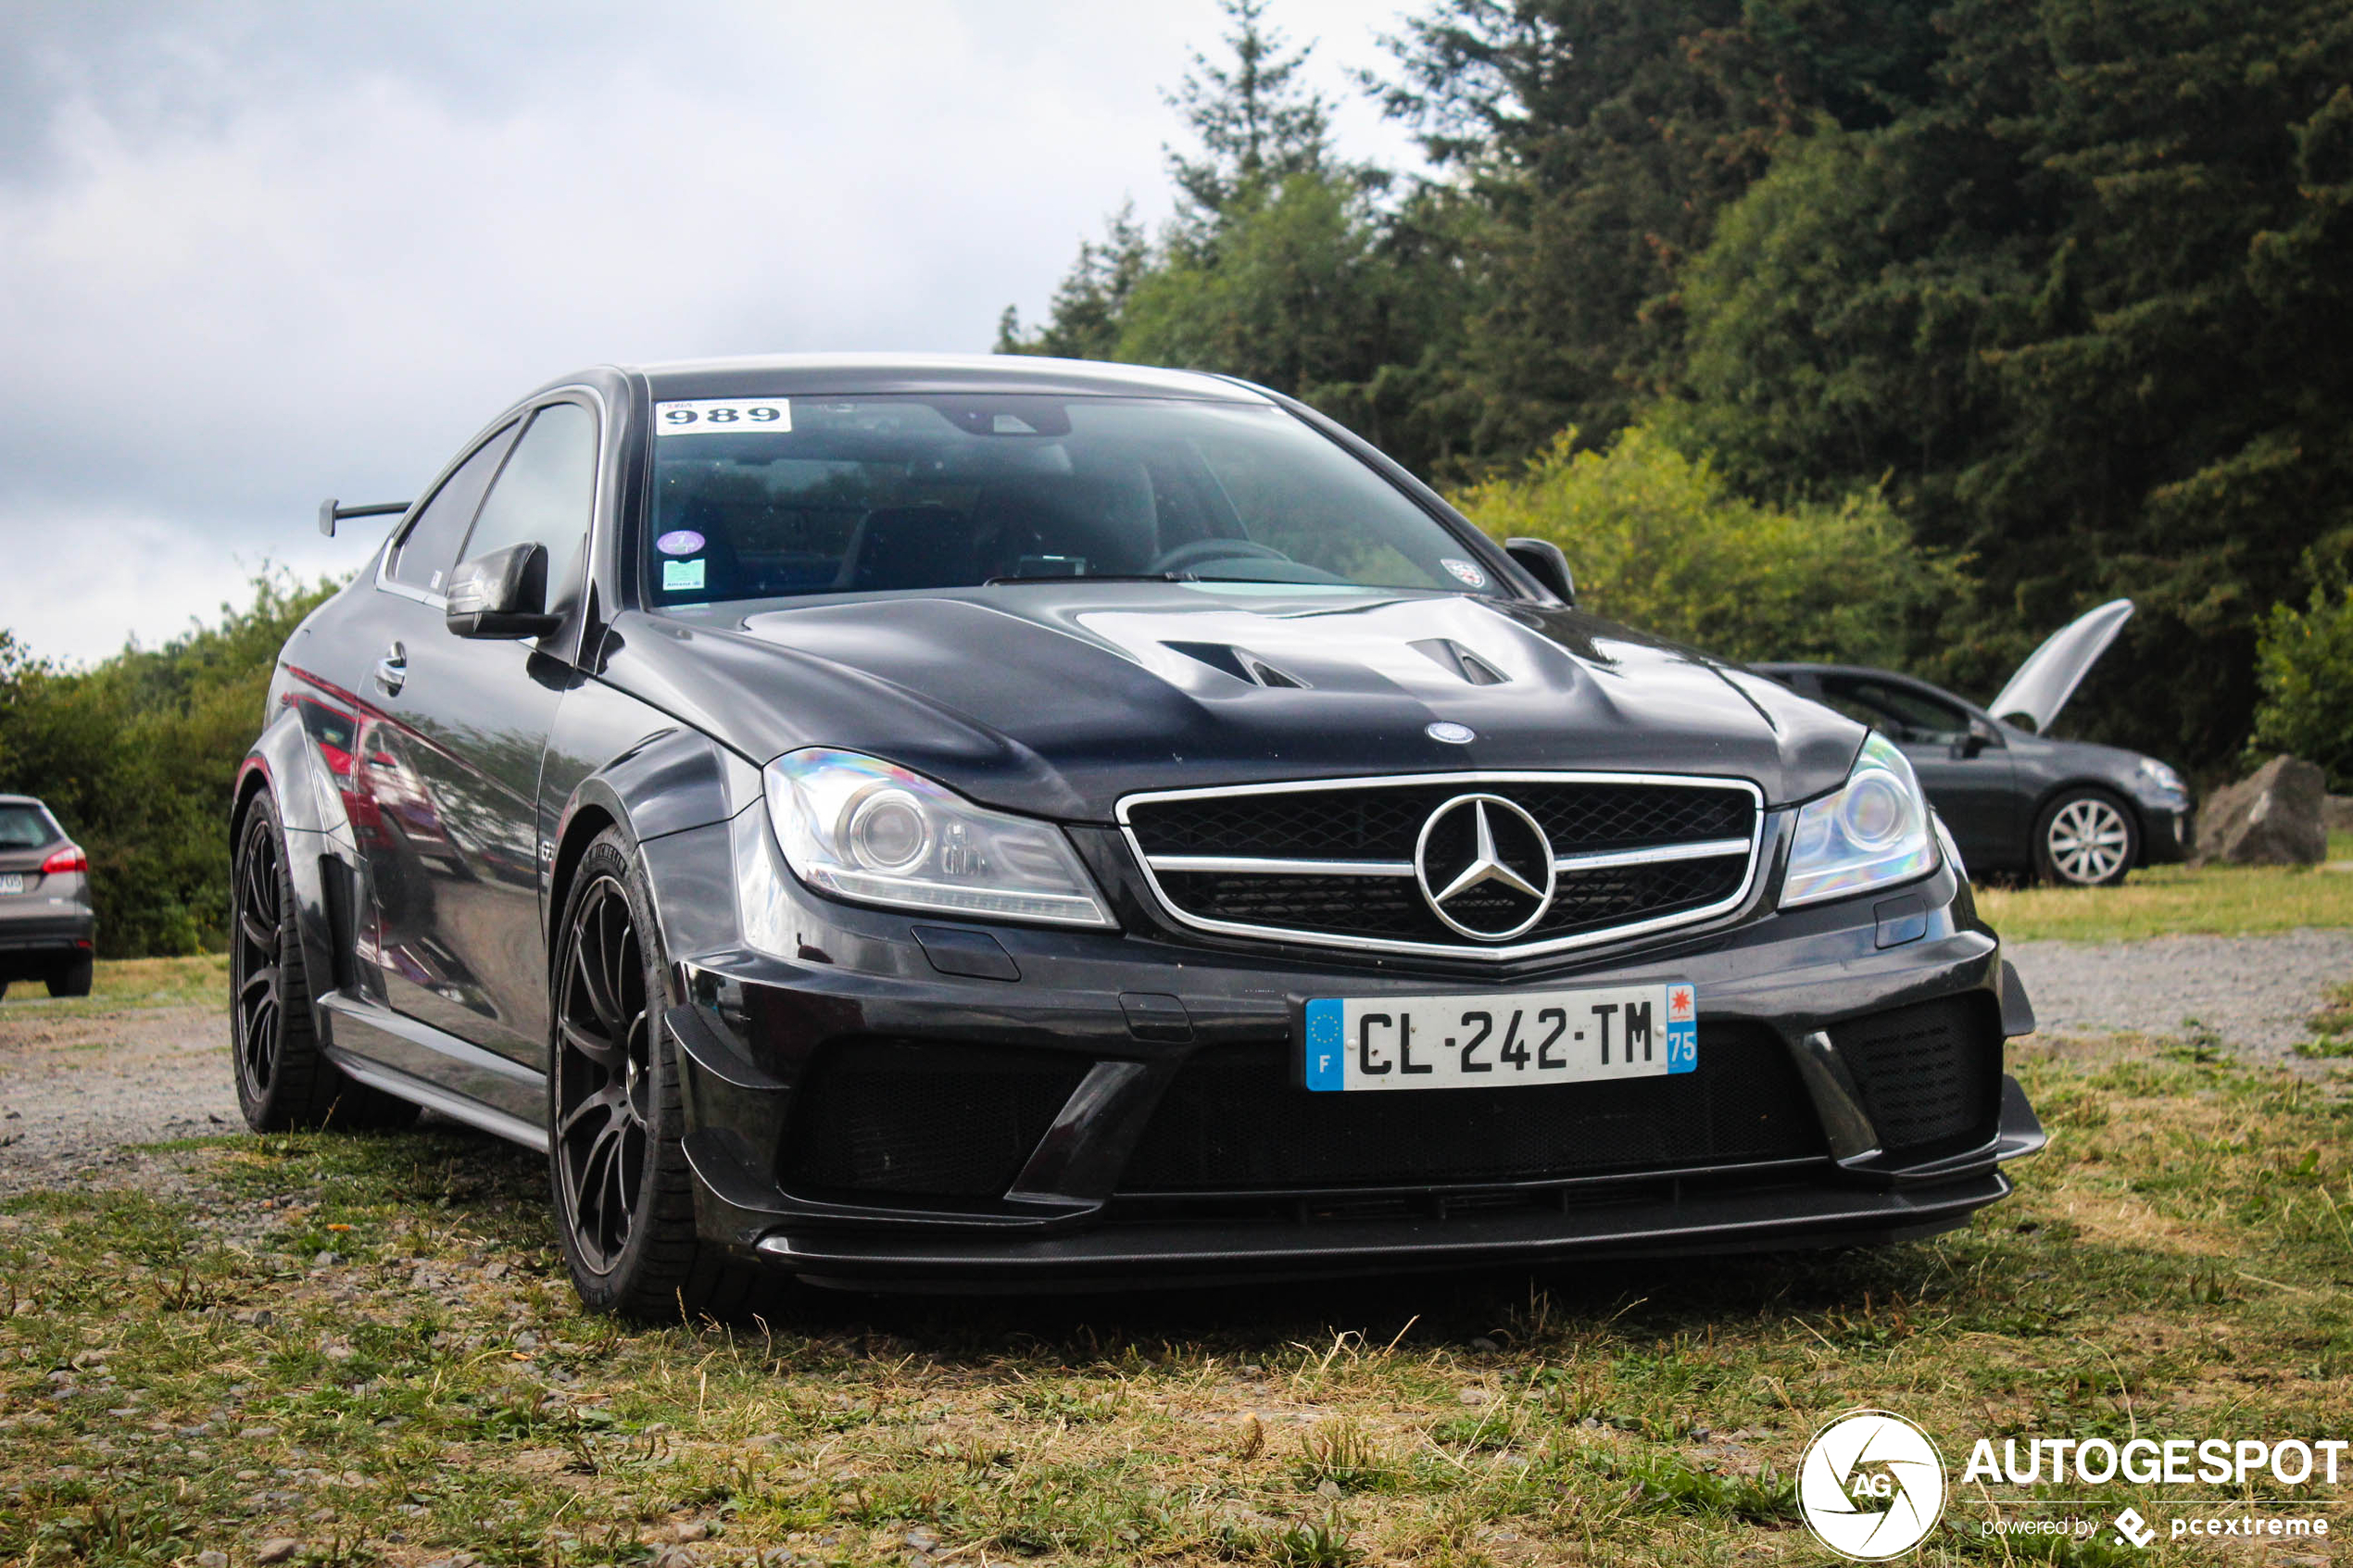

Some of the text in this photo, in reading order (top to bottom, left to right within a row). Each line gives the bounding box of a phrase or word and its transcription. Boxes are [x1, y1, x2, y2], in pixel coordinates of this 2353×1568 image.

[665, 407, 781, 425] 989
[1668, 1031, 1695, 1062] 75
[1318, 1055, 1331, 1073] F
